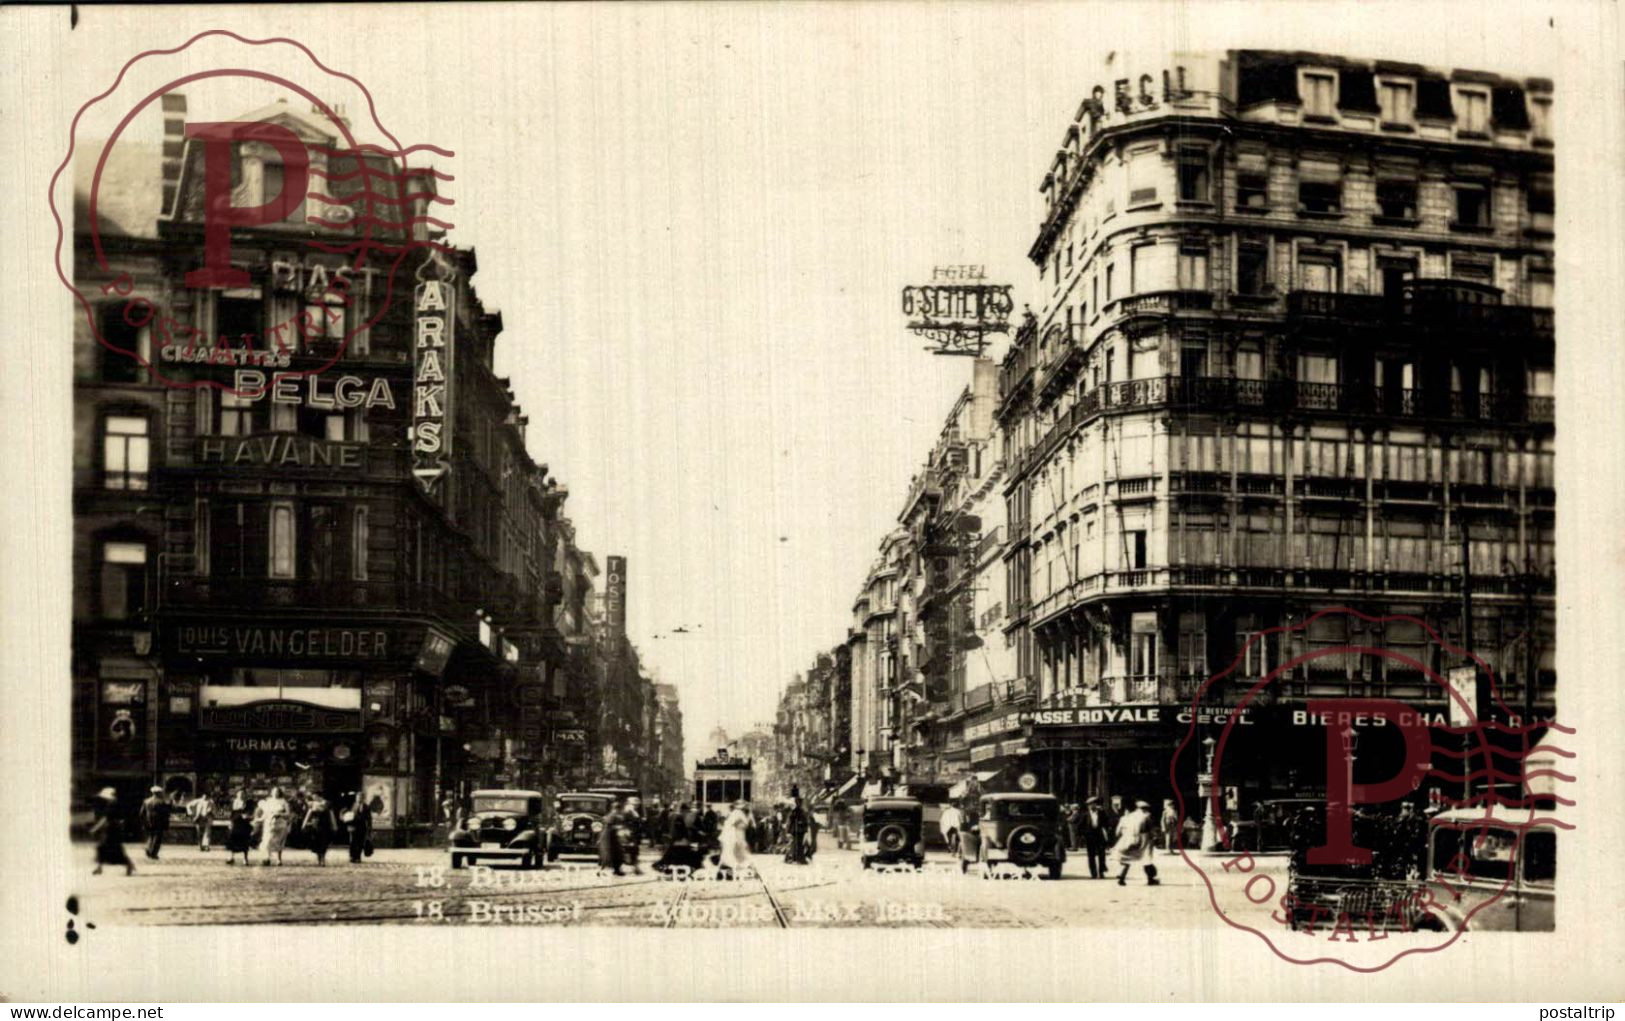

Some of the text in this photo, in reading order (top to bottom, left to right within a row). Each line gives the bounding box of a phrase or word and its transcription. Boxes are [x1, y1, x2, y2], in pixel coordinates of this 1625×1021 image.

[416, 281, 445, 452] ARAKS
[234, 369, 396, 410] BELGA
[202, 435, 361, 467] HAVANE
[177, 626, 230, 654] LOUIS
[1079, 709, 1160, 724] ROYALE
[1176, 713, 1255, 725] CECIL
[1293, 710, 1387, 727] BIERES
[226, 737, 298, 751] TURMAC
